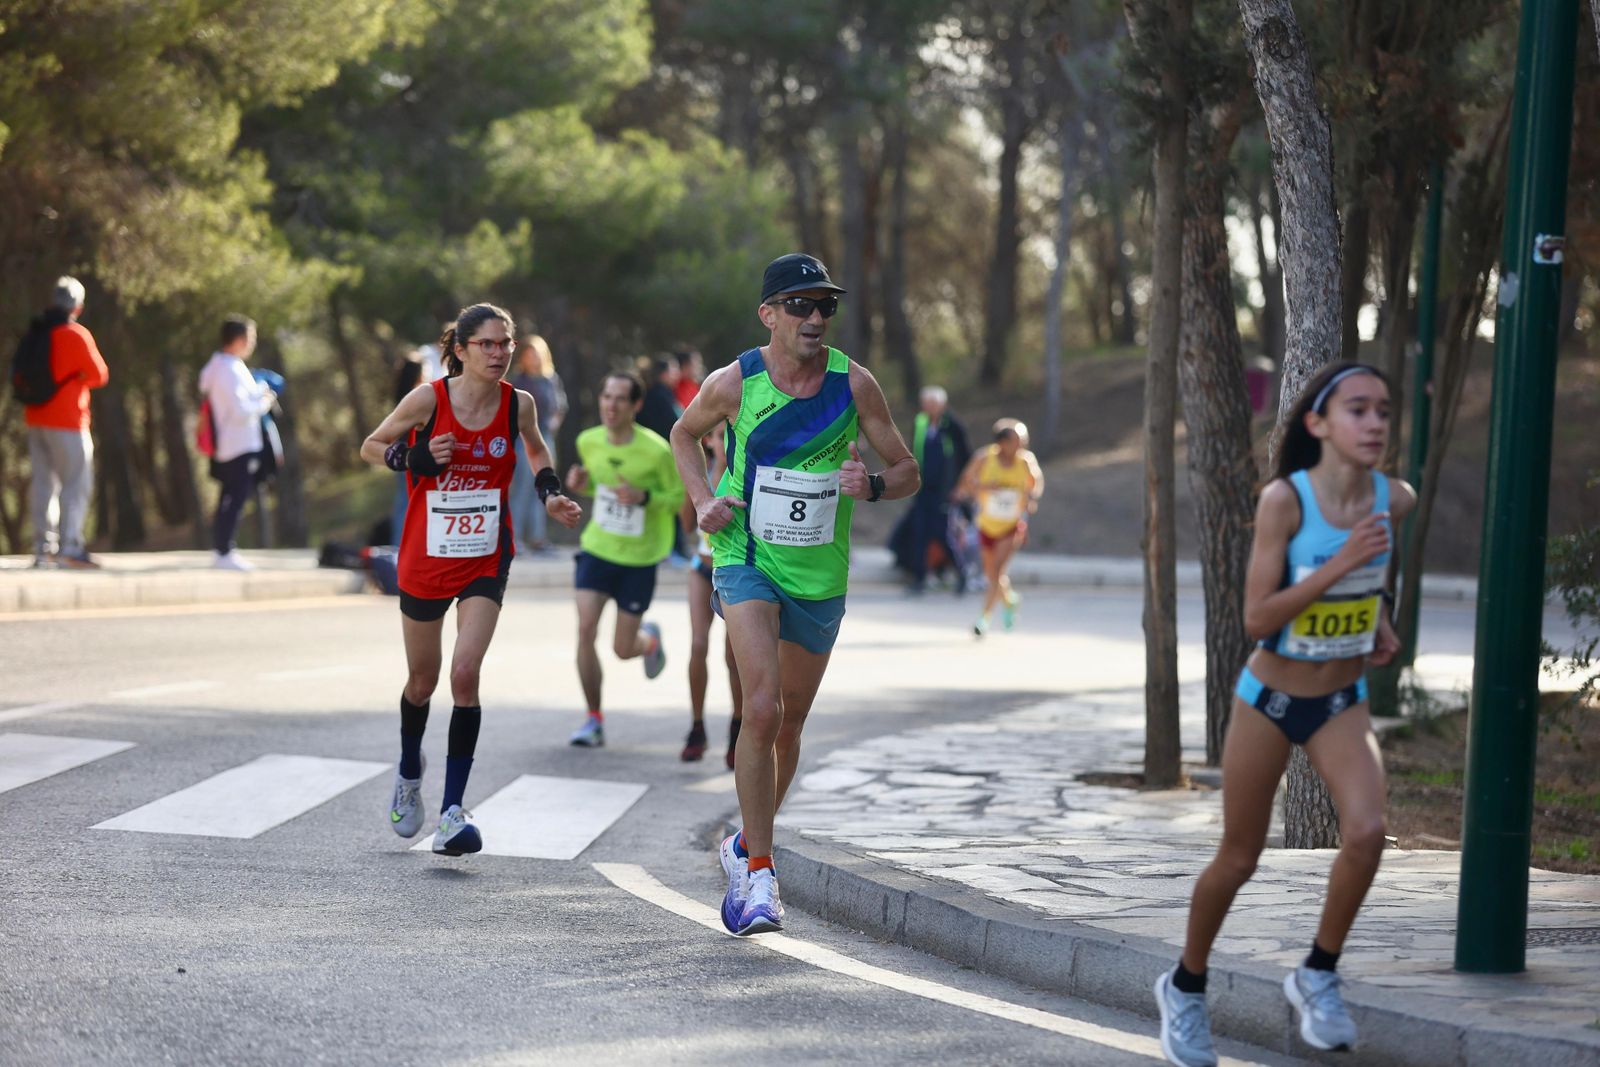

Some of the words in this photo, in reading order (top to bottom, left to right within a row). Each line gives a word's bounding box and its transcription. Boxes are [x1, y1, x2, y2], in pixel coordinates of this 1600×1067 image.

[790, 500, 806, 522] 8
[444, 514, 486, 535] 782
[1304, 609, 1370, 637] 1015
